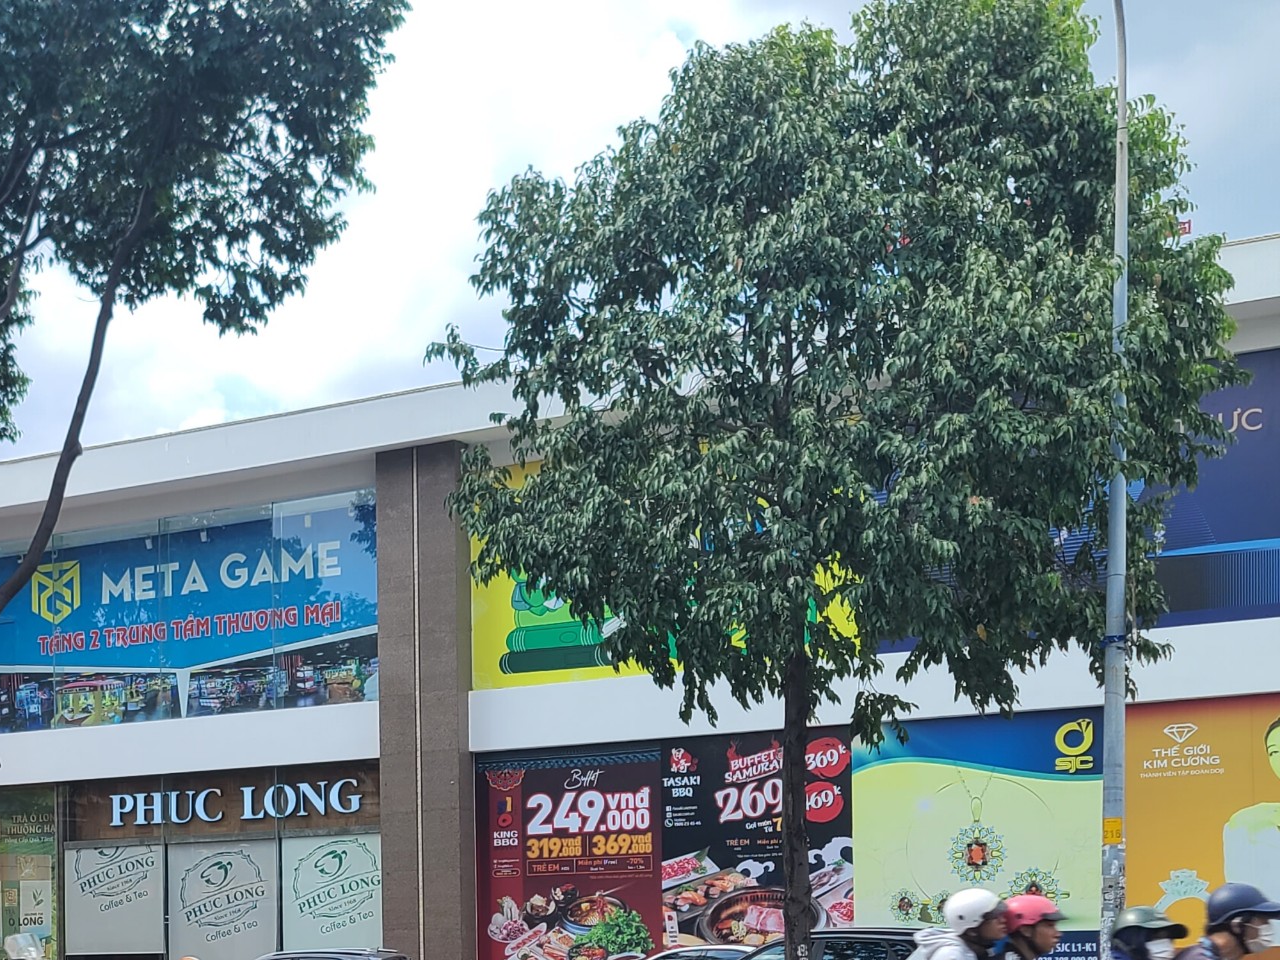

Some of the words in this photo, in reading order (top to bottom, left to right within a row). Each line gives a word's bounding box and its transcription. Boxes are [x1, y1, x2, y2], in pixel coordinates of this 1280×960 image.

[101, 558, 209, 605] META
[219, 540, 342, 589] GAME
[89, 629, 100, 650] 2
[103, 621, 167, 648] TRUNG
[171, 613, 211, 641] TÂM
[304, 600, 341, 627] MẠI
[731, 749, 776, 771] BUFFET
[1152, 744, 1180, 758] THẾ
[1183, 743, 1211, 756] GIỚI
[1143, 759, 1168, 769] KIM
[1171, 755, 1220, 768] CƯƠNG
[563, 768, 605, 790] Buffet
[662, 775, 701, 788] TASAKI
[109, 788, 223, 827] PHUC
[239, 778, 363, 820] LONG
[672, 787, 693, 798] BBQ
[493, 830, 519, 838] KING
[493, 838, 519, 847] BBQ
[739, 838, 750, 846] EM
[79, 866, 115, 894] PHUC
[118, 855, 155, 876] LONG
[548, 863, 560, 872] EM
[99, 898, 124, 913] Coffee
[133, 890, 149, 900] Tea
[184, 895, 223, 923] PHUC
[226, 885, 266, 905] LONG
[297, 887, 337, 914] PHUC
[340, 874, 382, 896] LONG
[19, 916, 44, 927] LONG
[205, 927, 232, 943] Coffee
[242, 920, 258, 931] Tea
[320, 919, 347, 935] Coffee
[359, 910, 375, 921] Tea
[1055, 942, 1070, 953] SJC
[1071, 942, 1097, 952] L1-K1
